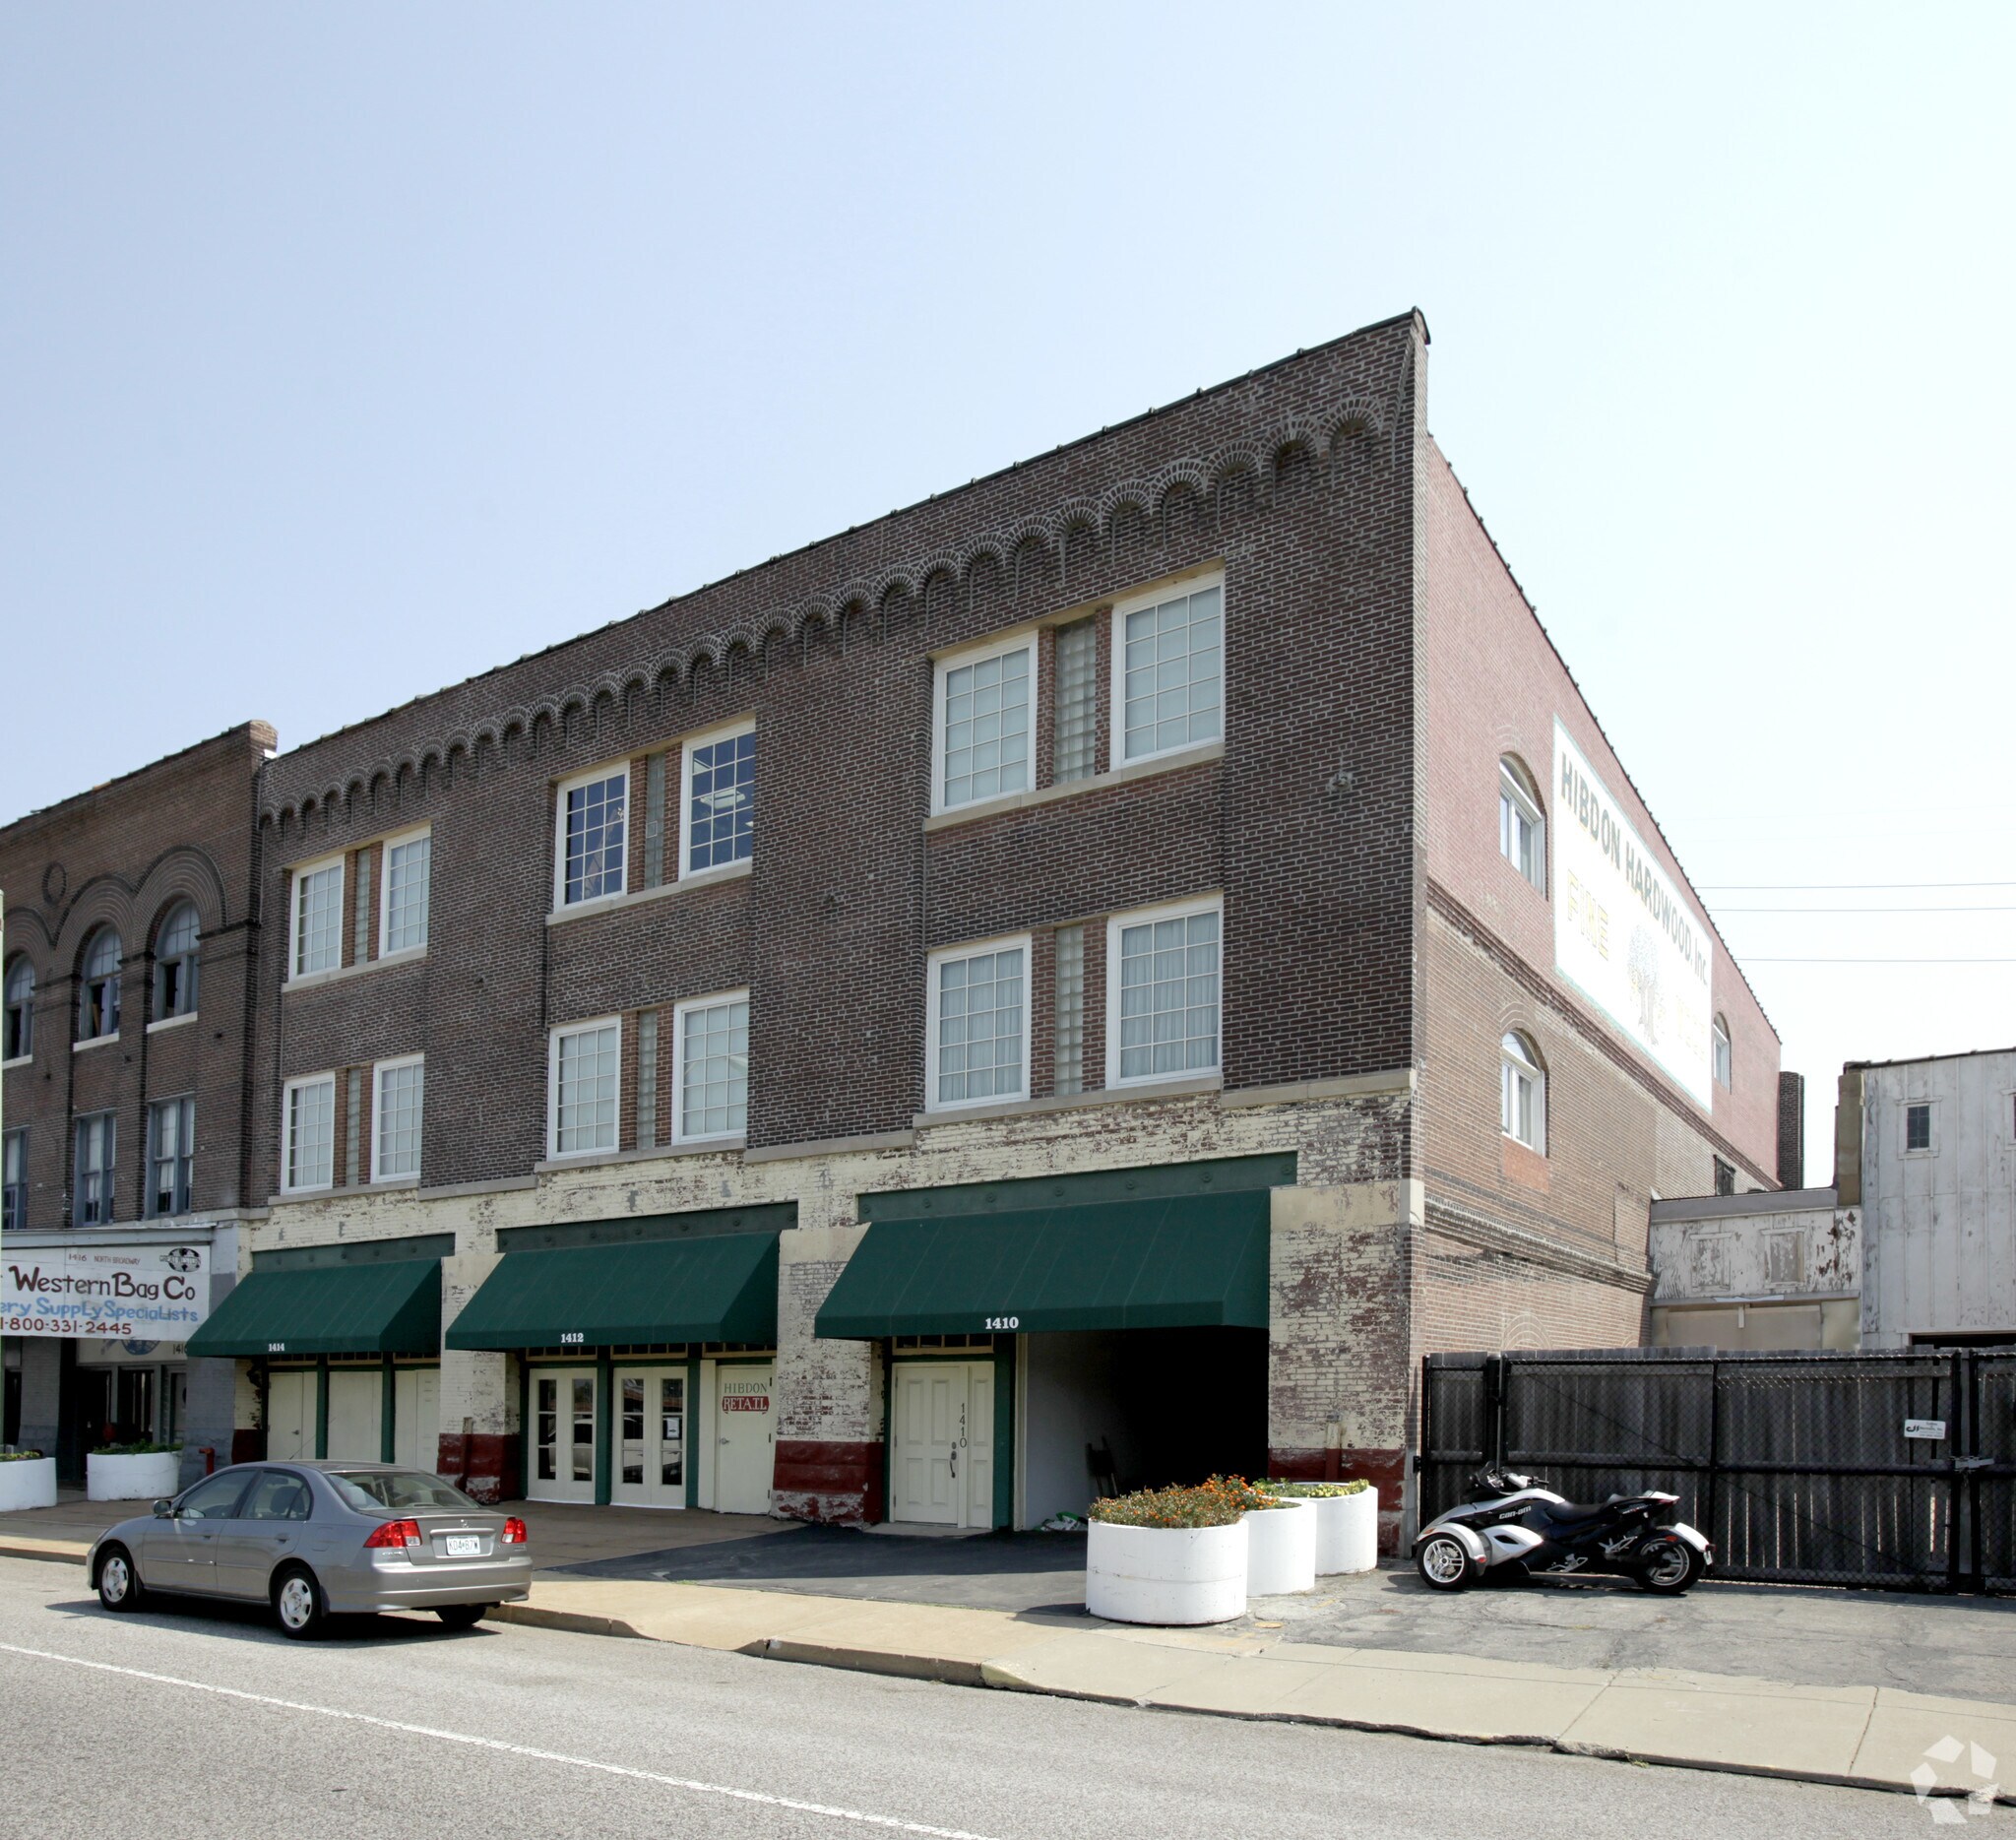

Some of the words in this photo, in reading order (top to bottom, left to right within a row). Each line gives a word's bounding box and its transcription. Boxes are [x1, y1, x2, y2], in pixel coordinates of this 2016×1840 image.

[1561, 751, 1621, 872] HIBDON
[1567, 868, 1609, 962] FINE
[94, 1255, 111, 1264] NORTH
[112, 1256, 141, 1266] BROADWAY
[8, 1265, 110, 1296] Western
[111, 1272, 158, 1301] Bag
[162, 1276, 196, 1301] Co
[0, 1316, 132, 1335] 1-800-331-2445
[985, 1316, 1020, 1330] 1410
[560, 1332, 585, 1344] 1412
[268, 1343, 285, 1352] 1414
[724, 1382, 768, 1394] HIBDON
[724, 1397, 767, 1411] RETAIL
[959, 1402, 968, 1448] 1410
[1498, 1505, 1532, 1520] can-am
